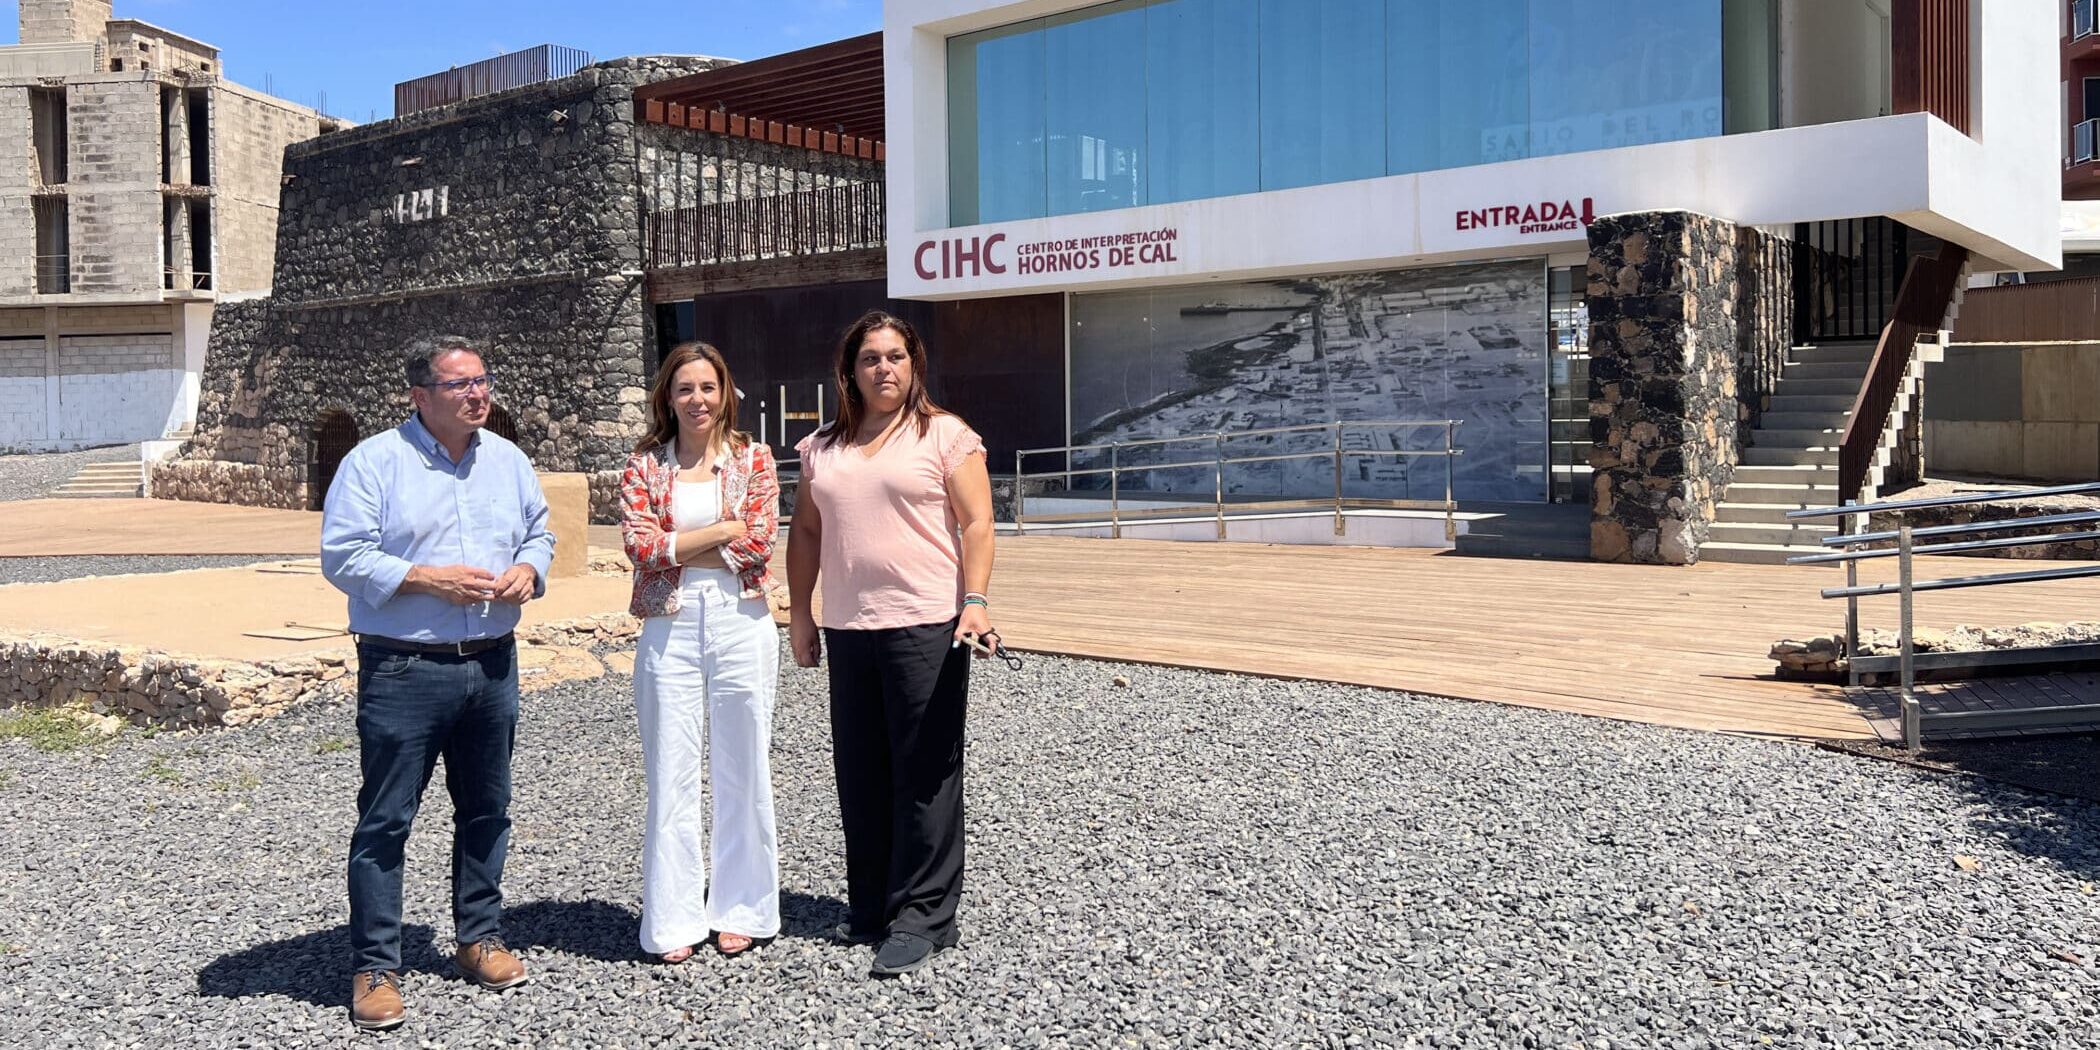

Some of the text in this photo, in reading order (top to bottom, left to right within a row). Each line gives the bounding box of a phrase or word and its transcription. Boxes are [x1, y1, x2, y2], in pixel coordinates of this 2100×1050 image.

[1456, 200, 1577, 230] ENTRADA
[1520, 221, 1577, 234] ENTRANCE
[1017, 227, 1177, 255] CENTRO DE INTERPRETACIÓN
[914, 233, 1007, 280] CIHC
[1018, 242, 1177, 275] HORNOS DE CAL
